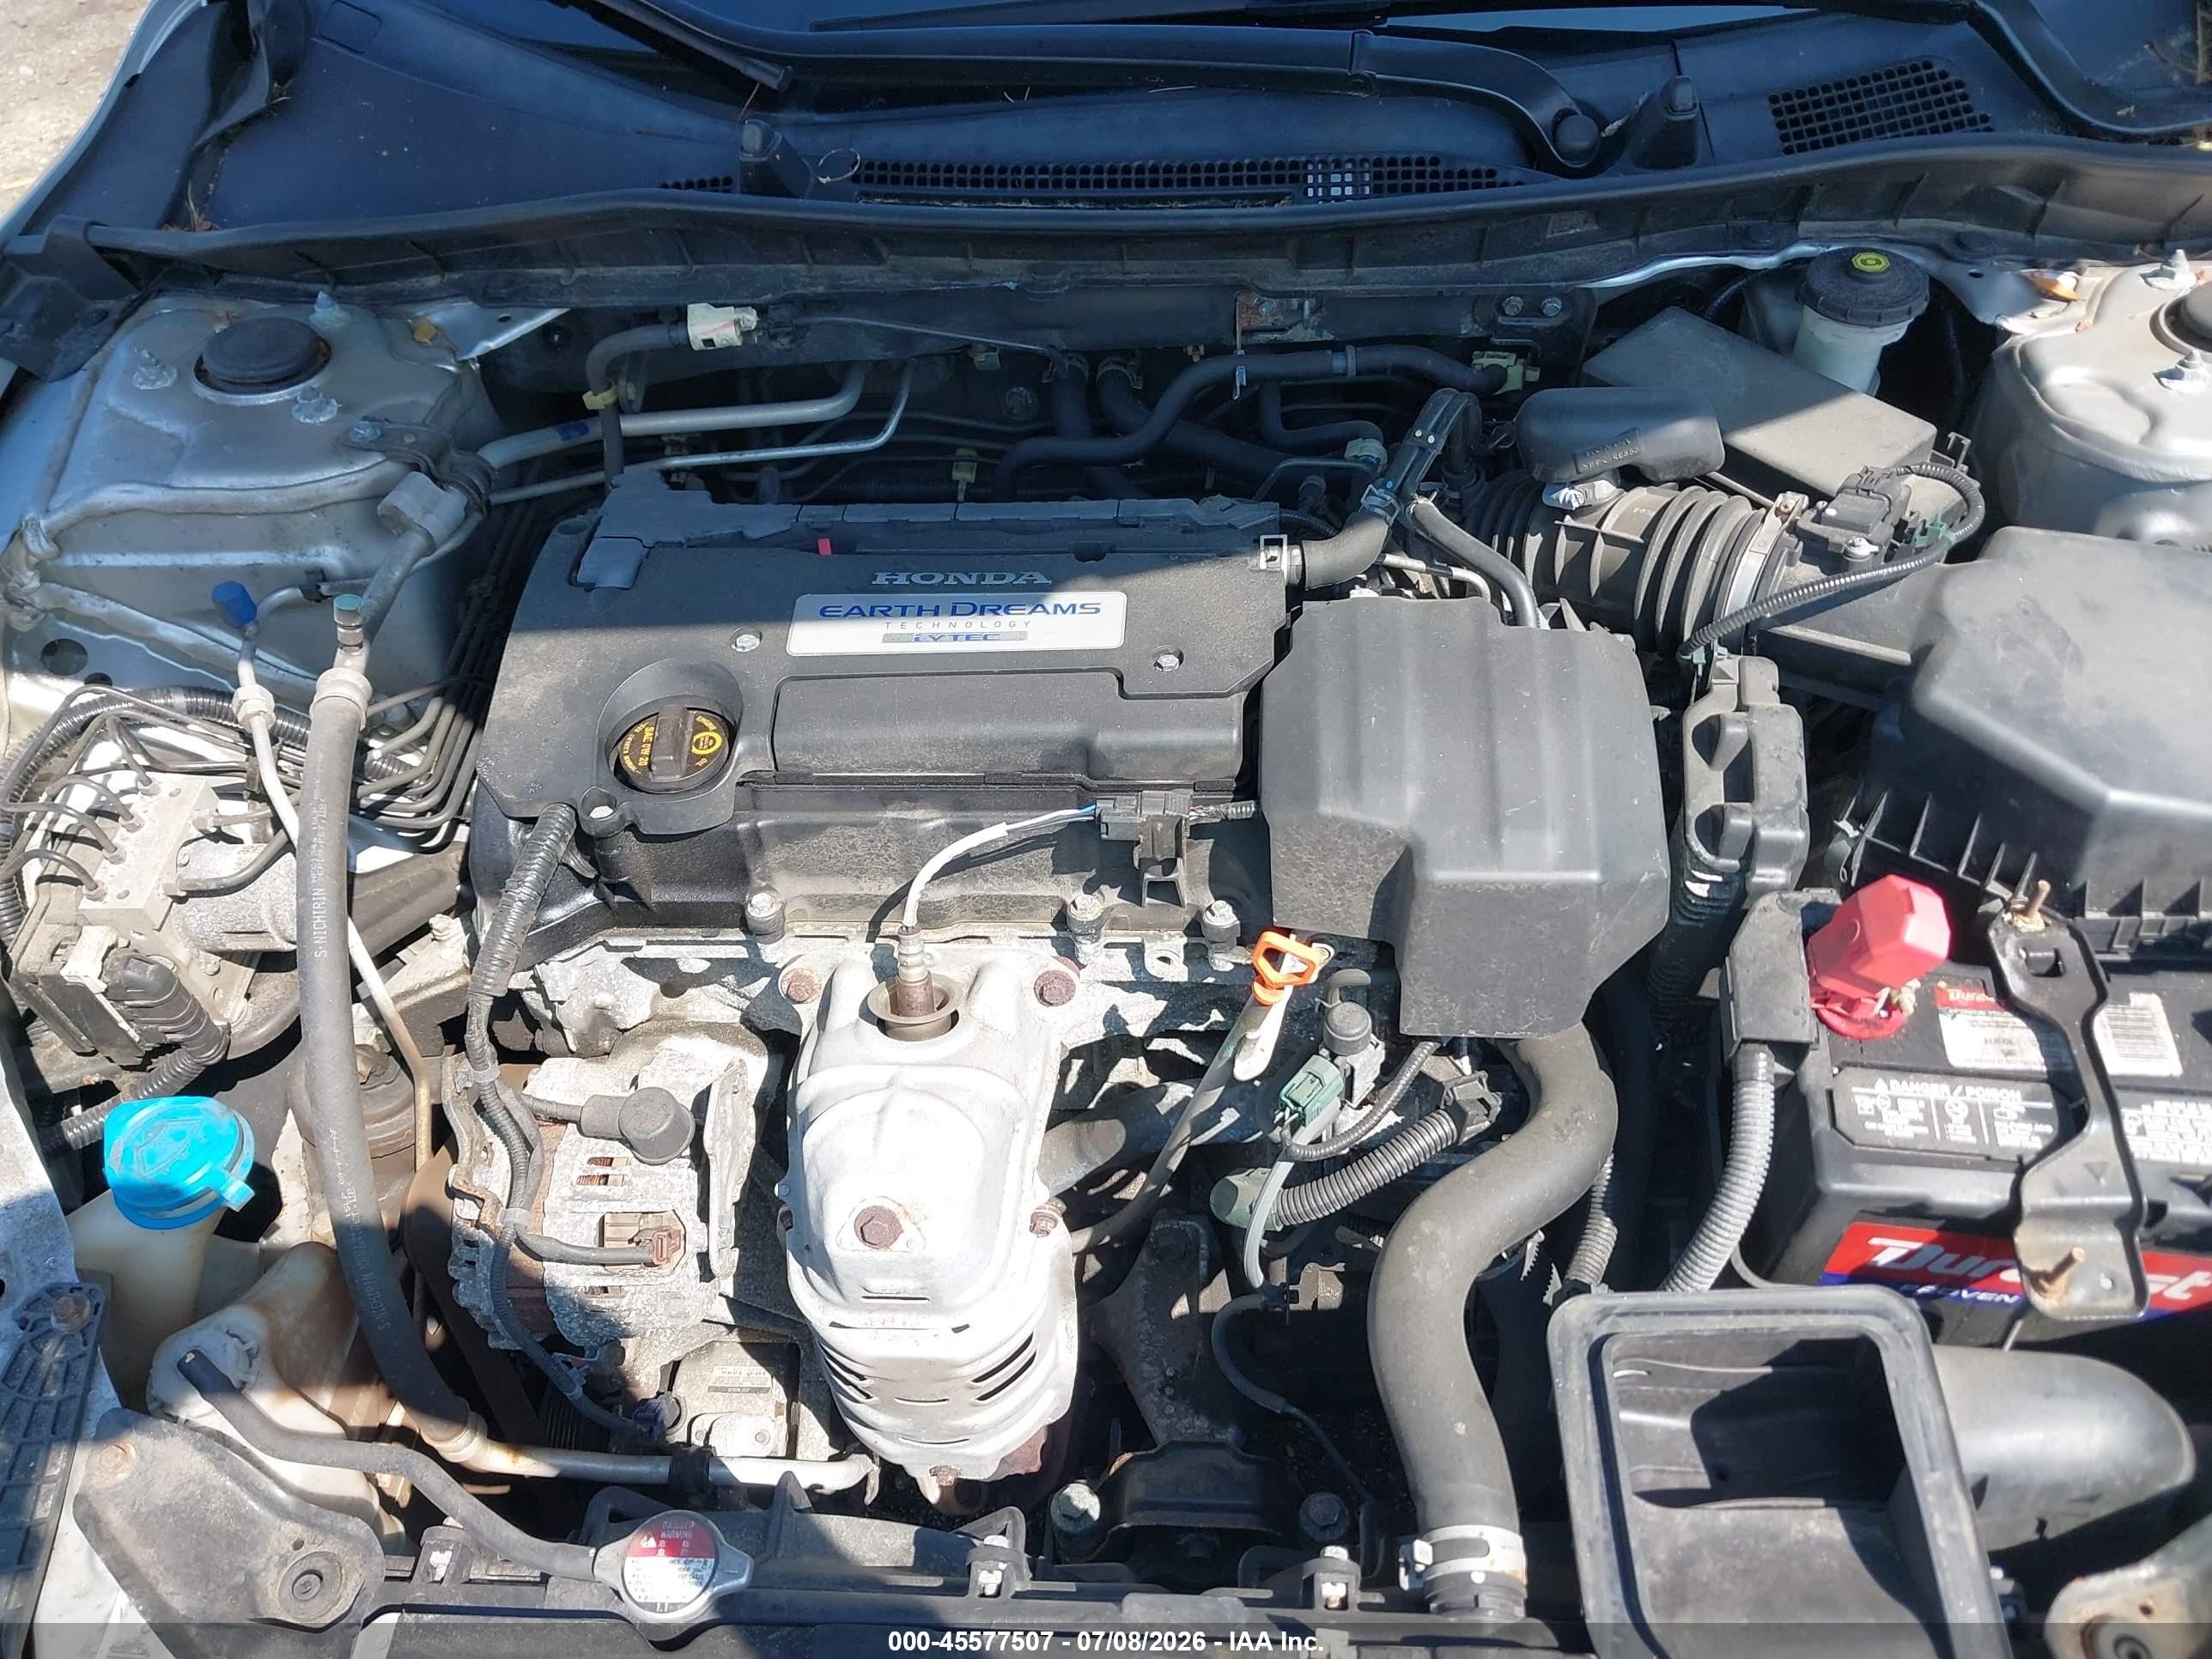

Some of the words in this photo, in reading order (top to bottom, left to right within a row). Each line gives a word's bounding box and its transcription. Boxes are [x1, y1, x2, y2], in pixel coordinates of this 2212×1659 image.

[871, 571, 1052, 586] HONDA
[818, 604, 941, 618] EARTH
[950, 601, 1102, 617] DREAMS
[884, 620, 1031, 630] TECHNOLOGY
